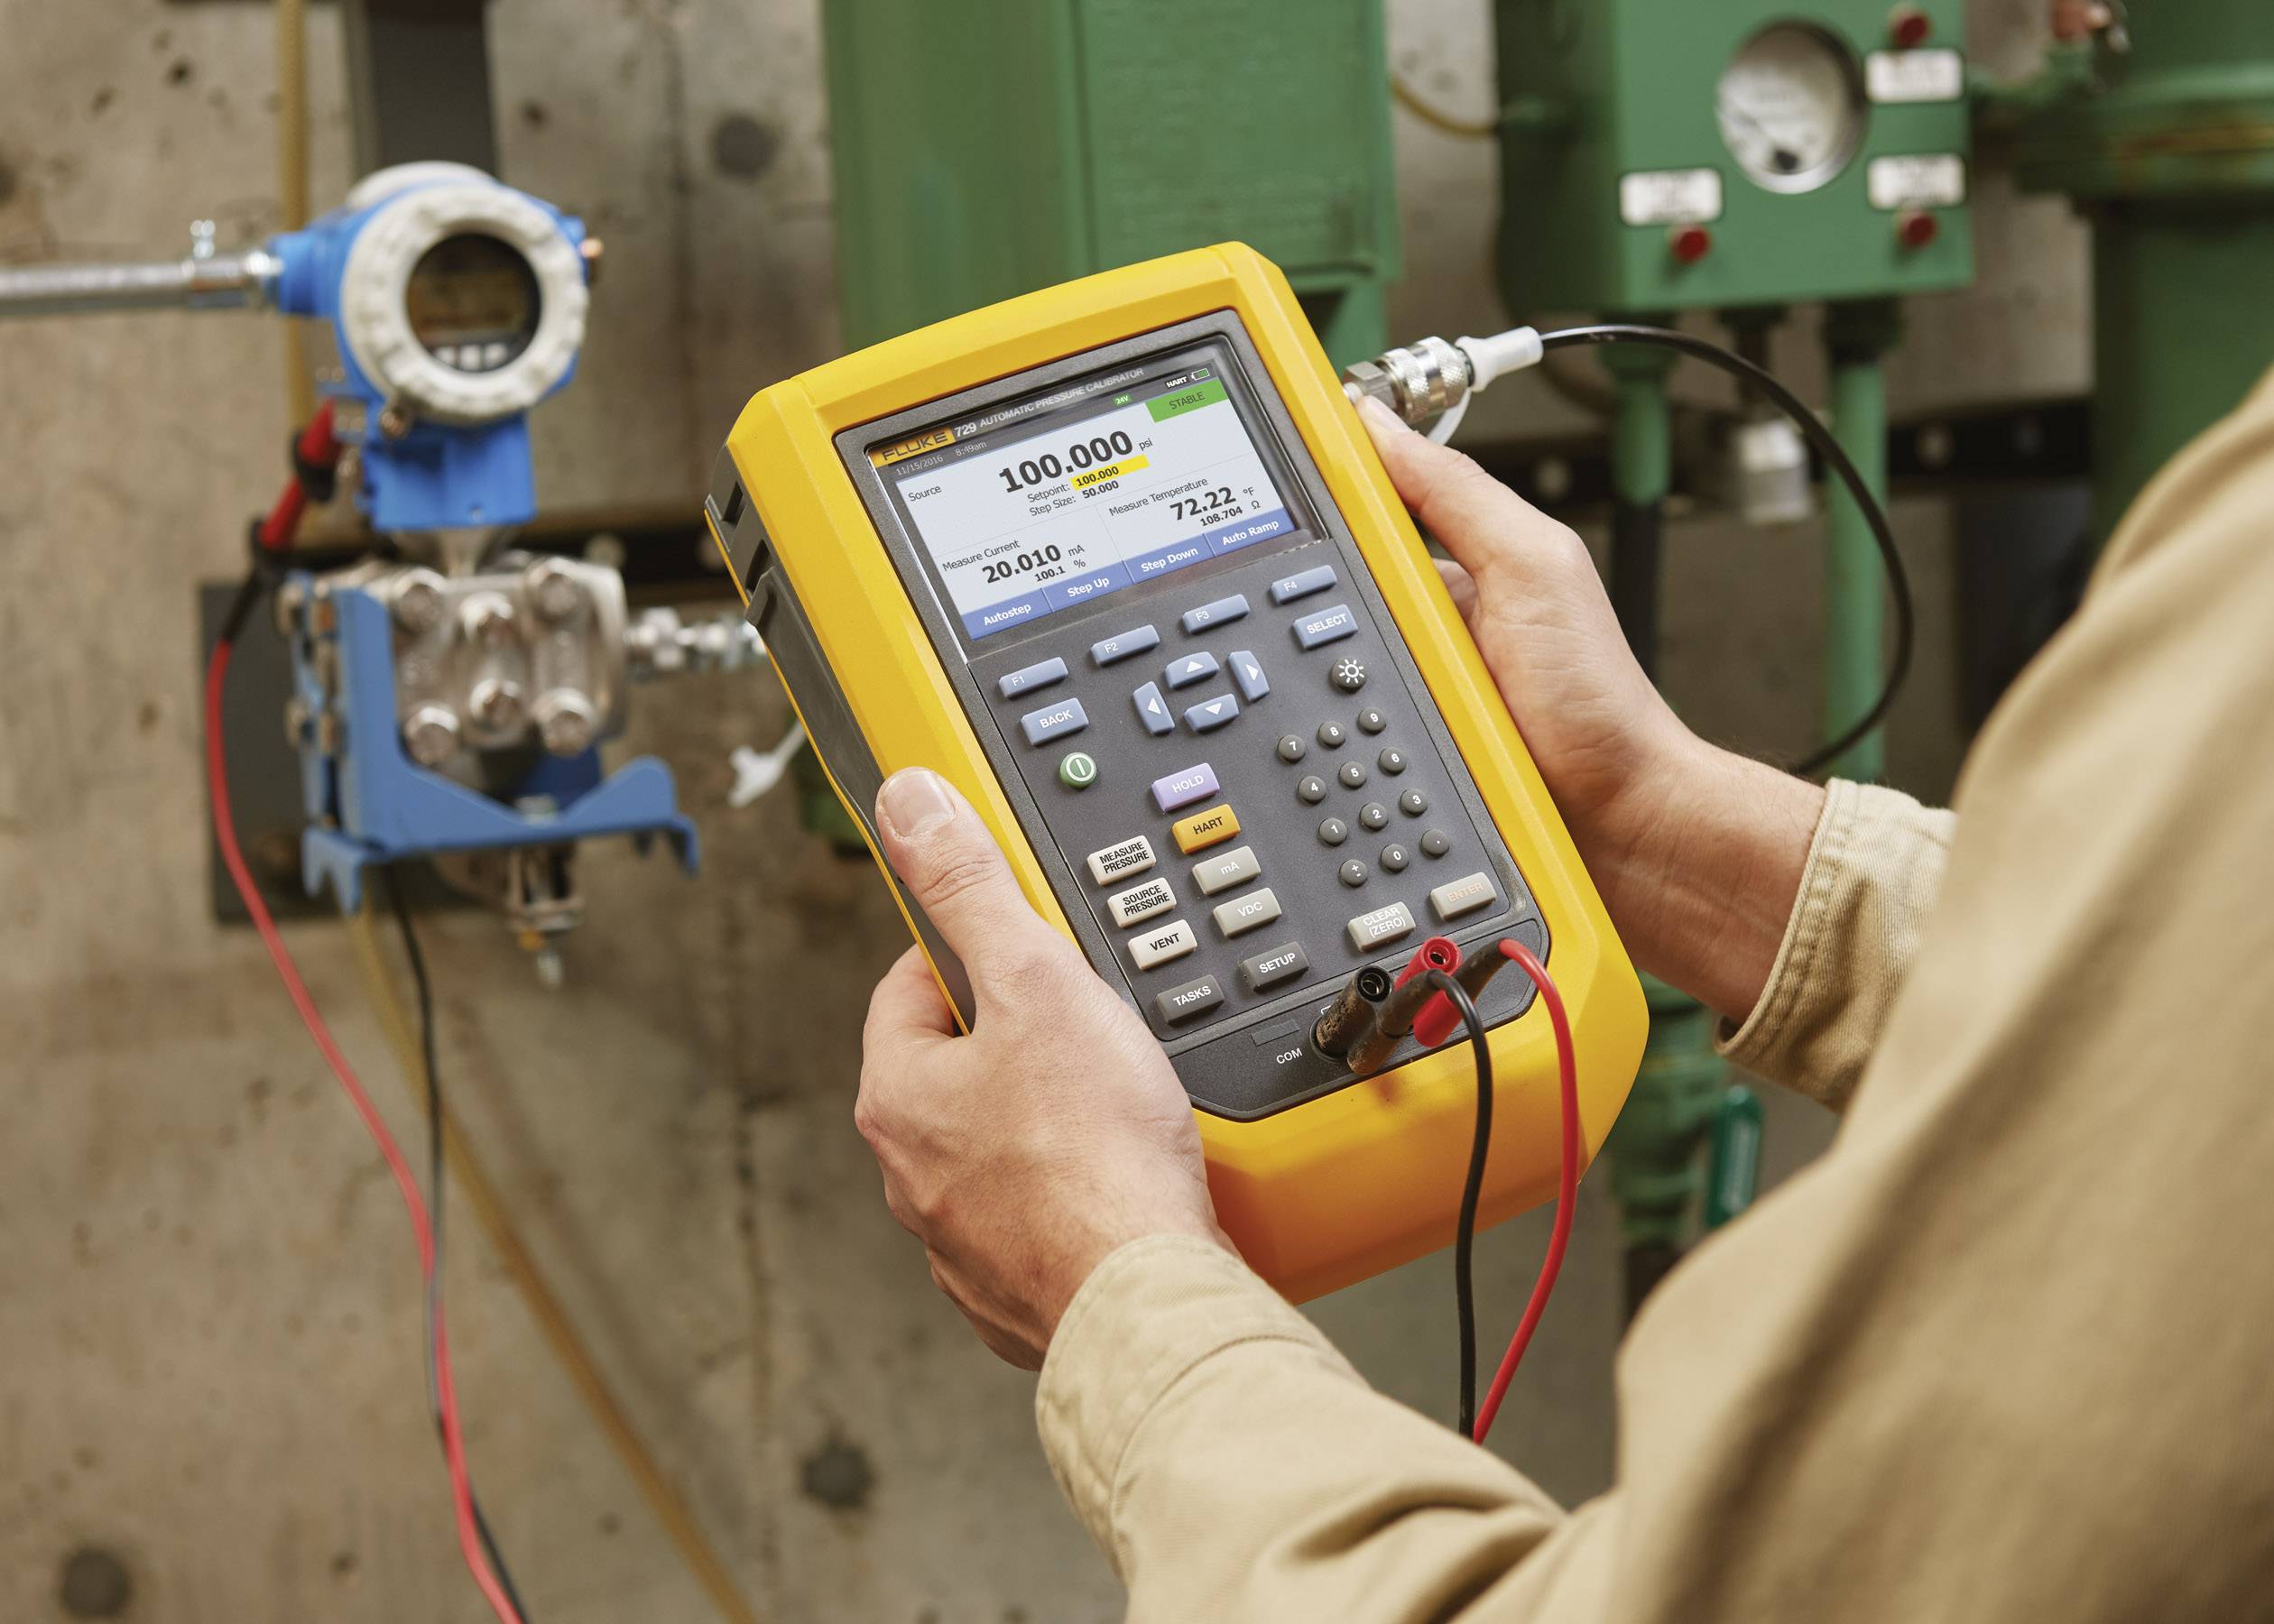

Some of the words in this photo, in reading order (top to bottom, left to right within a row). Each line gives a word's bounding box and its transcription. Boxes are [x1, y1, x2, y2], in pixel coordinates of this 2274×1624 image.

[1166, 376, 1188, 388] HART
[1115, 395, 1129, 404] 24V
[1169, 392, 1206, 410] STABLE
[882, 431, 948, 461] FLUKE
[955, 422, 977, 438] 729
[980, 402, 1035, 428] AUTOMATIC
[1035, 387, 1086, 409] PRESSURE
[1086, 367, 1144, 392] CALIBRATOR
[896, 455, 944, 475] 11/15/2016
[955, 441, 987, 457] 8:49am
[999, 430, 1133, 494] 100.000
[1139, 438, 1153, 451] psi
[908, 485, 942, 502] Source
[1027, 484, 1070, 503] Setpoint:
[1076, 466, 1120, 486] 100.000
[1029, 503, 1052, 516] Step
[1053, 495, 1076, 509] Size:
[1082, 480, 1120, 499] 50.000
[1109, 497, 1150, 516] Measure
[1149, 478, 1208, 503] Temperature
[1169, 486, 1236, 521] 72.22
[1199, 505, 1243, 527] 108.704
[1222, 531, 1247, 546] Auto
[1248, 520, 1280, 537] Ramp
[942, 552, 983, 572] Measure
[984, 540, 1021, 558] Current
[982, 544, 1061, 584] 20.010
[1068, 544, 1086, 557] mA
[1141, 558, 1166, 572] Step
[1168, 547, 1199, 564] Down
[1034, 566, 1066, 582] 100.1
[1074, 559, 1086, 568] %
[1067, 583, 1092, 597] Step
[1094, 577, 1110, 588] Up
[1284, 581, 1298, 592] F4
[984, 604, 1031, 625] Autostep
[1196, 611, 1209, 621] F3
[1307, 613, 1347, 634] SELECT
[1105, 642, 1119, 653] F2
[1012, 676, 1025, 687] F1
[1039, 709, 1074, 728] BACK
[1370, 713, 1379, 722] 9
[1330, 726, 1339, 736] 8
[1289, 741, 1298, 751] 7
[1391, 753, 1400, 762] 6
[1350, 768, 1359, 778] 5
[1172, 774, 1205, 794] HOLD
[1311, 782, 1318, 792] 4
[1412, 795, 1421, 805] 3
[1373, 809, 1382, 819] 2
[1192, 817, 1224, 835] HART
[1331, 825, 1339, 834] 1
[1099, 841, 1144, 863] MEASURE
[1103, 850, 1150, 874] PRESSURE
[1393, 851, 1401, 861] 0
[1219, 861, 1240, 875] mA
[1122, 884, 1162, 905] SOURCE
[1447, 882, 1484, 902] ENTER
[1123, 892, 1170, 917] PRESSURE
[1236, 901, 1263, 918] VDC
[1363, 907, 1401, 927] CLEAR
[1369, 916, 1407, 938] (ZERO)
[1150, 933, 1180, 951] VENT
[1259, 952, 1296, 973] SETUP
[1173, 985, 1212, 1007] TASKS
[1276, 1047, 1303, 1065] COM
